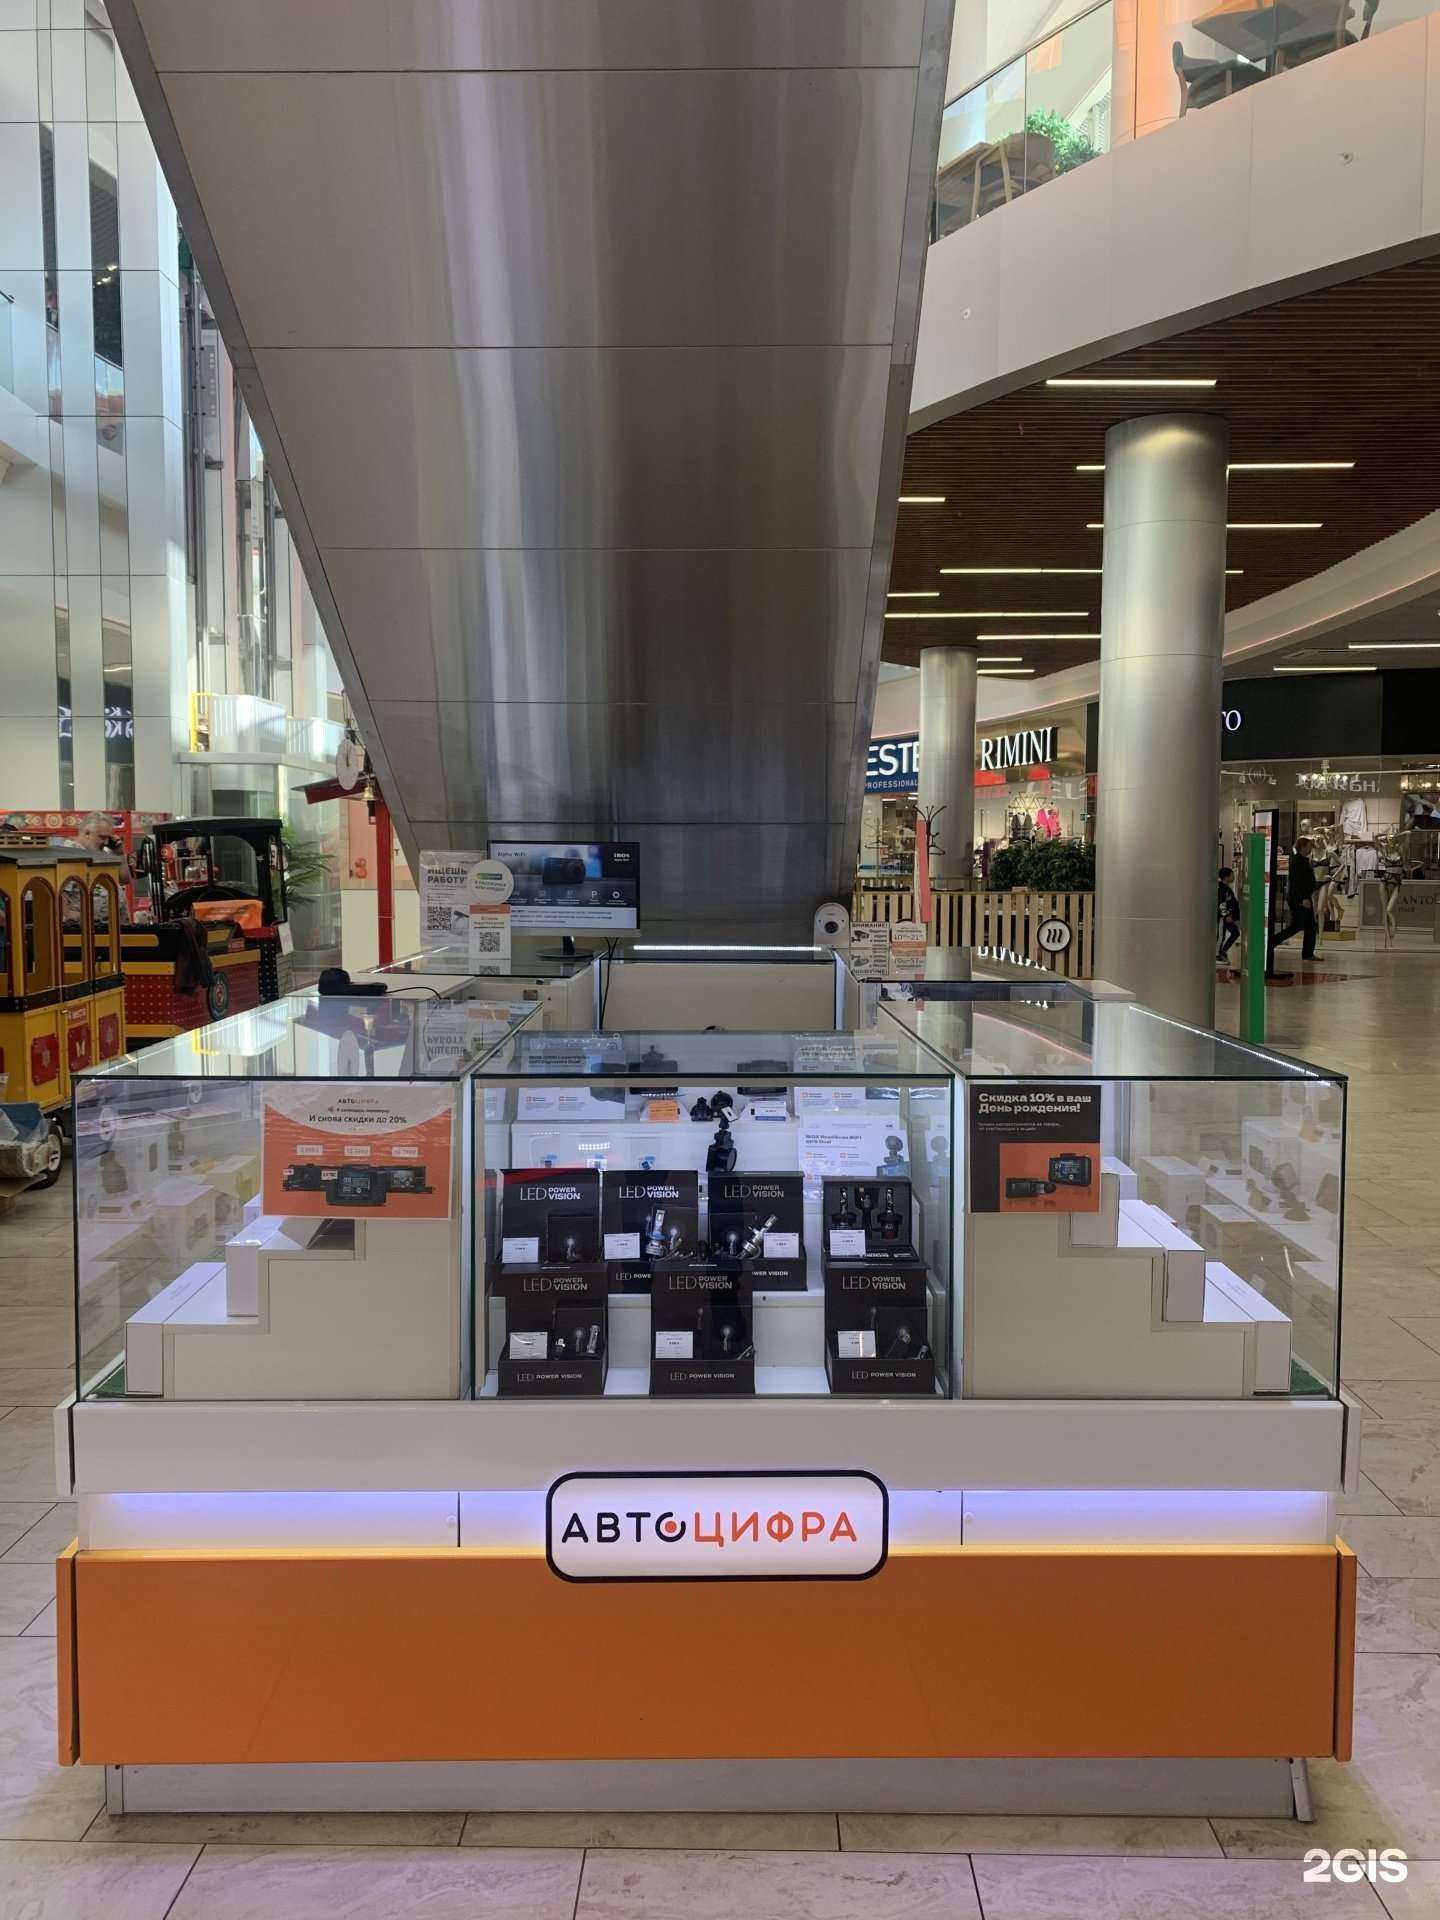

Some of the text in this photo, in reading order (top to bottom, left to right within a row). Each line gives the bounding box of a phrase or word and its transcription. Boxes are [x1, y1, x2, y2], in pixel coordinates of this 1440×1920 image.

[980, 727, 1051, 771] RIMINI
[867, 779, 918, 789] ROFESSIONAL
[979, 1093, 1027, 1103] Скидка
[1030, 1093, 1055, 1102] 10%
[979, 1103, 1080, 1114] День рождения!
[389, 1116, 407, 1124] 20%
[520, 1187, 547, 1200] LED
[619, 1186, 646, 1198] LED
[724, 1184, 751, 1198] LED
[616, 1272, 631, 1280] LED
[523, 1278, 552, 1292] LED
[554, 1283, 588, 1291] VISION
[669, 1276, 696, 1289] LED
[842, 1276, 871, 1289] LED
[872, 1282, 906, 1290] VISION
[517, 1373, 533, 1381] LED
[670, 1372, 686, 1380] LED
[852, 1371, 868, 1379] LED
[561, 1511, 857, 1547] АВТОЦИФРА
